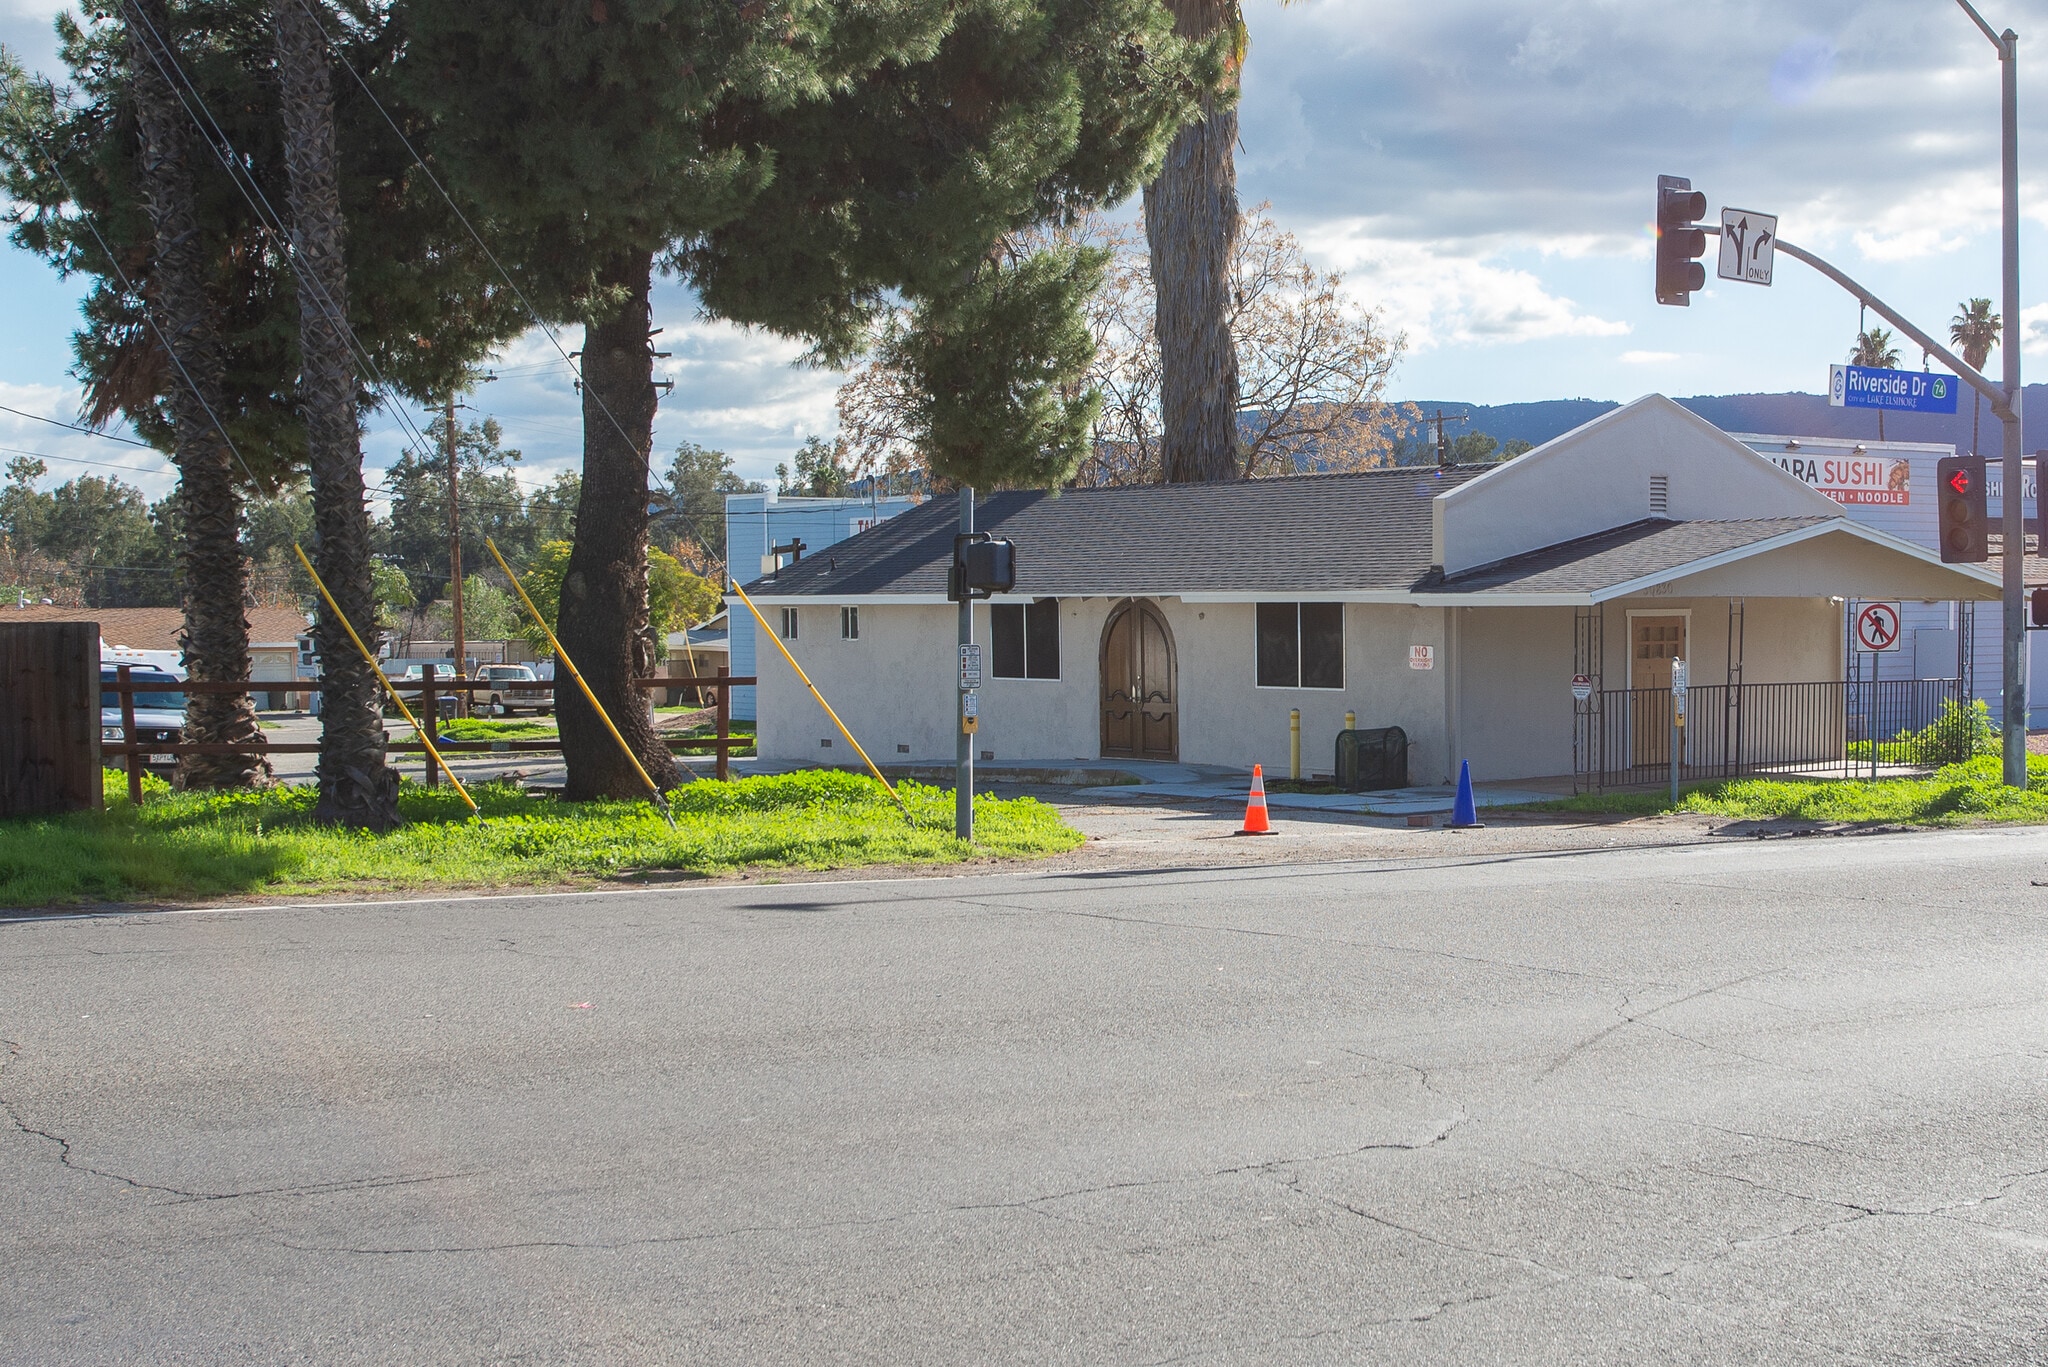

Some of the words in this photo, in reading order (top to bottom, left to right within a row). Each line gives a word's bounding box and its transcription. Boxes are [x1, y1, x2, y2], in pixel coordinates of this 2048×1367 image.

[1749, 267, 1769, 280] ONLY
[1849, 370, 1908, 395] Riverside
[1911, 376, 1927, 397] Dr
[1934, 384, 1944, 395] 74
[1867, 394, 1885, 405] LAKE
[1885, 395, 1918, 408] ELSINORE
[1772, 457, 1818, 483] ARA
[1823, 460, 1883, 486] SUSHI
[1857, 491, 1904, 504] NOODLE
[1414, 646, 1428, 657] NO
